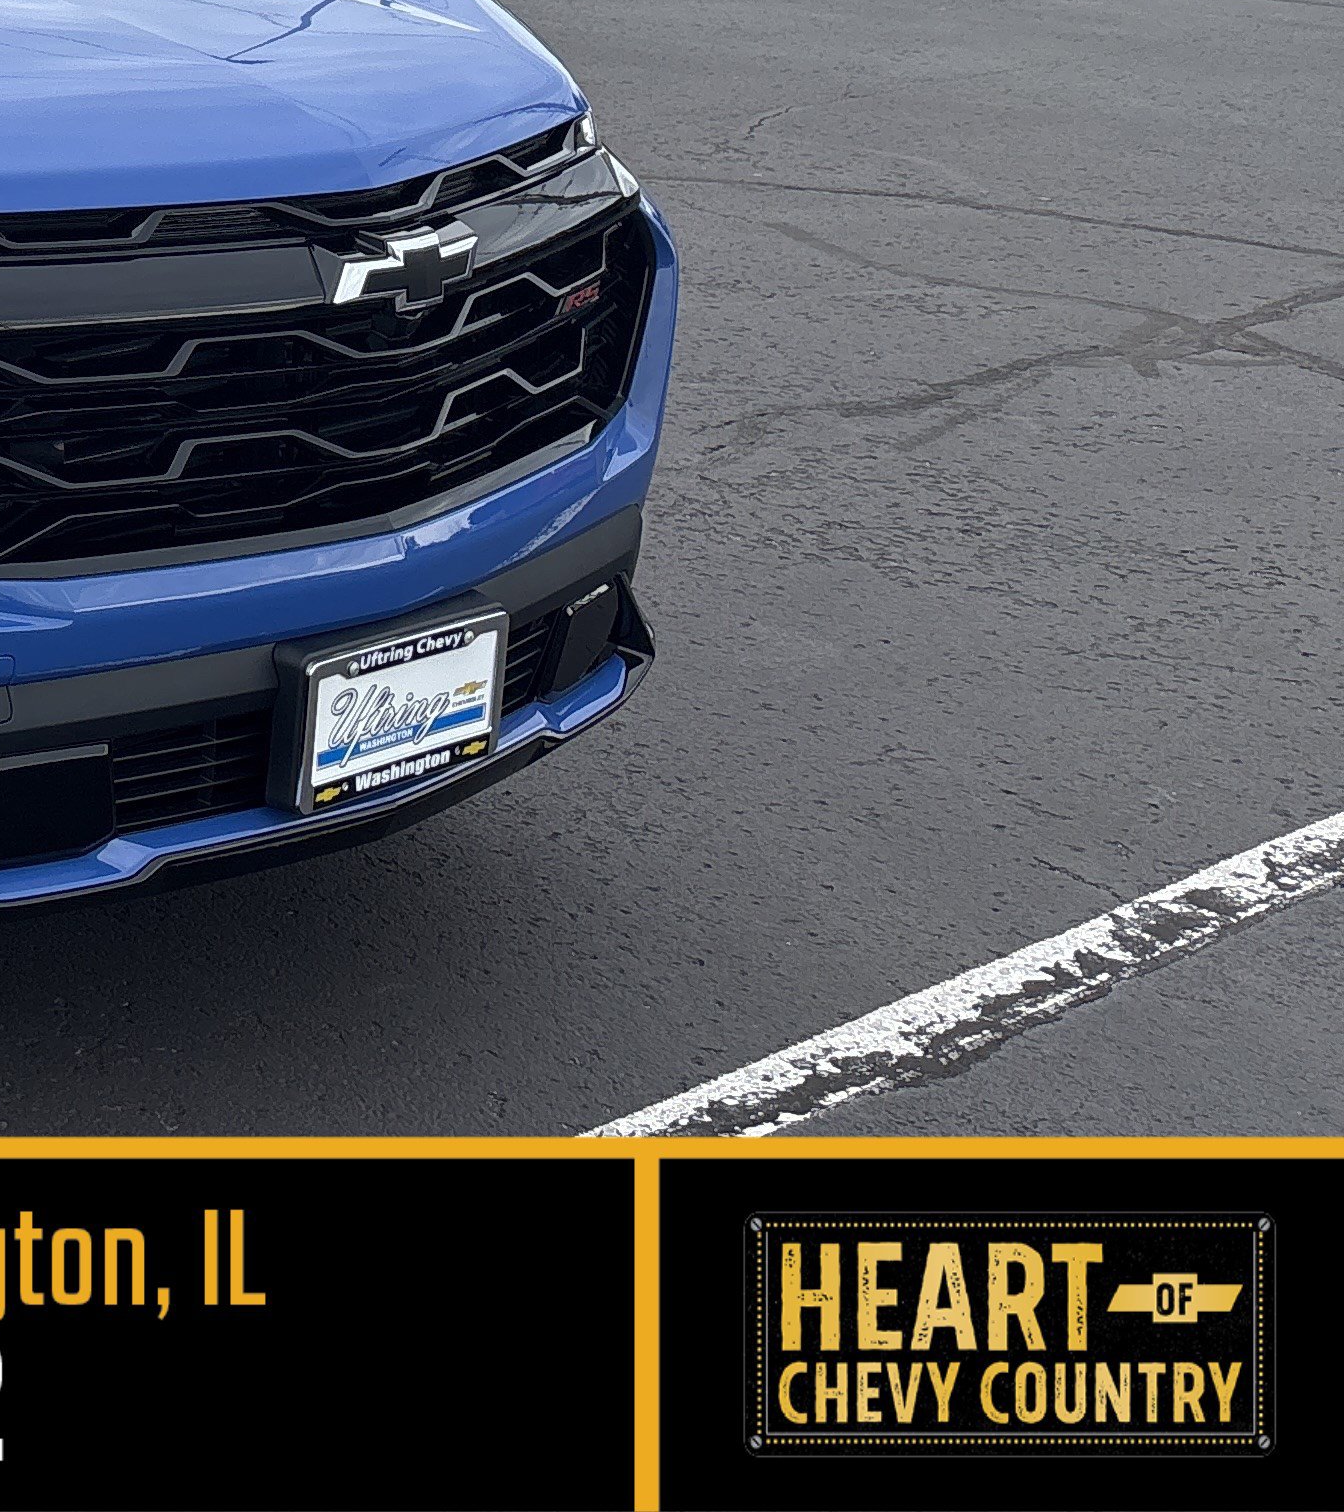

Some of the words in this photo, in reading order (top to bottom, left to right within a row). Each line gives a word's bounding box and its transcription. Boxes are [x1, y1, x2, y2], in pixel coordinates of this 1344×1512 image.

[359, 645, 413, 670] Uftring
[416, 631, 462, 655] Chevy
[328, 684, 450, 768] Uftring
[359, 728, 414, 752] WASHINGTON
[355, 750, 450, 792] Washington
